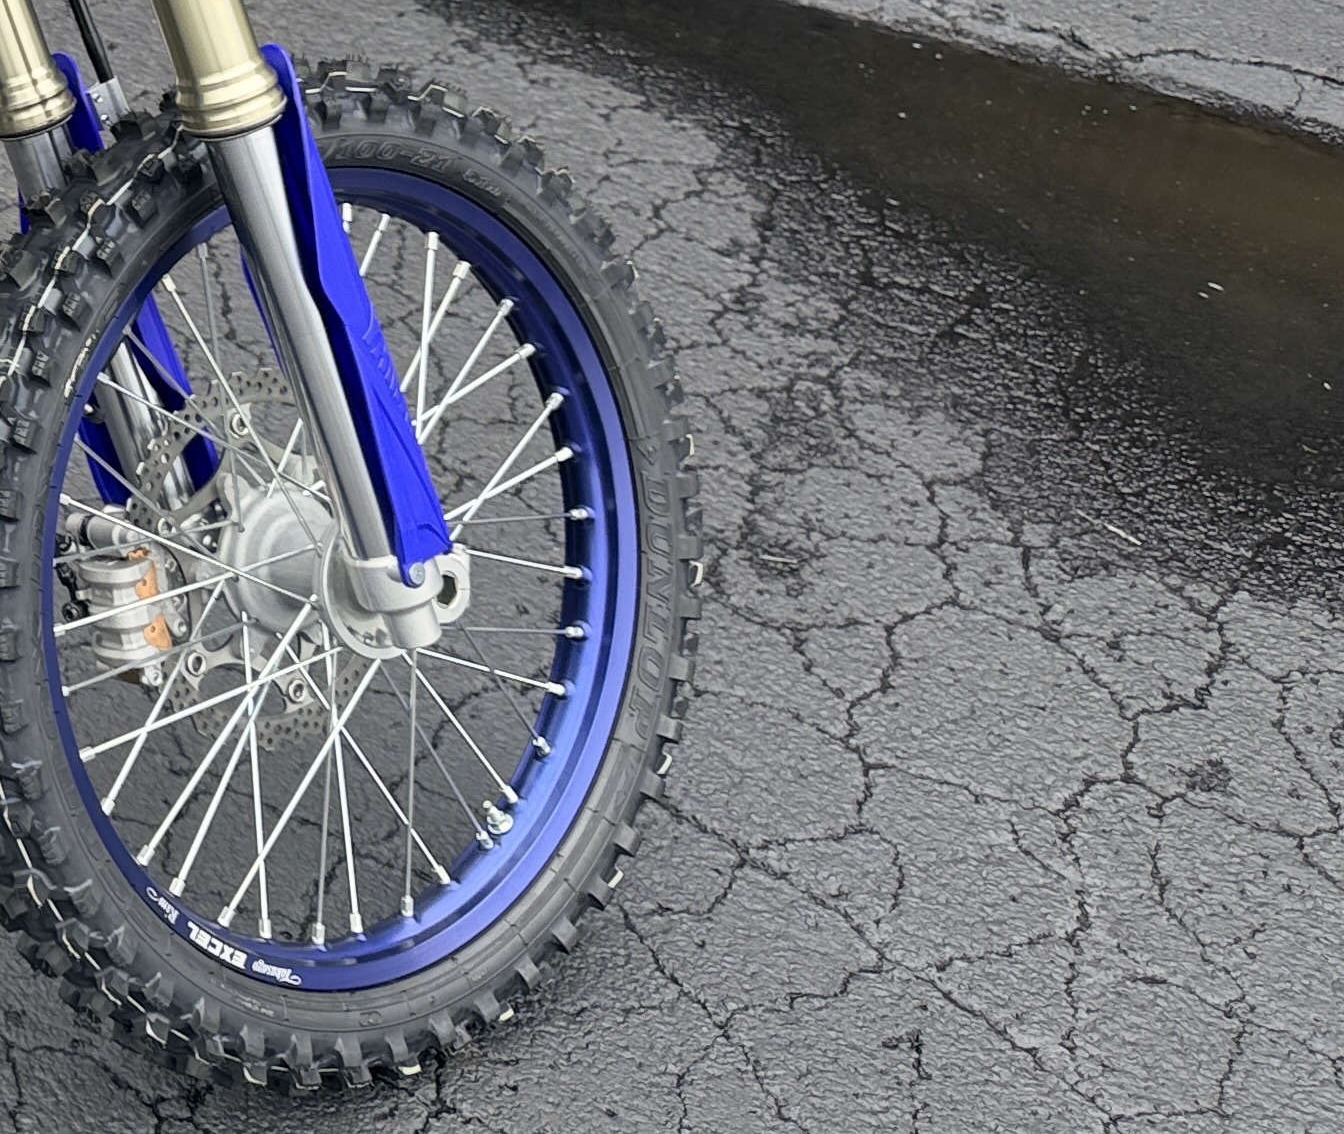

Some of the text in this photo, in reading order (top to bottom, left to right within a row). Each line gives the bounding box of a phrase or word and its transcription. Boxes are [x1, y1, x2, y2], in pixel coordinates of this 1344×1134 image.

[628, 471, 673, 750] DUNLOP
[146, 886, 180, 925] Rim
[187, 921, 248, 970] EXCEL
